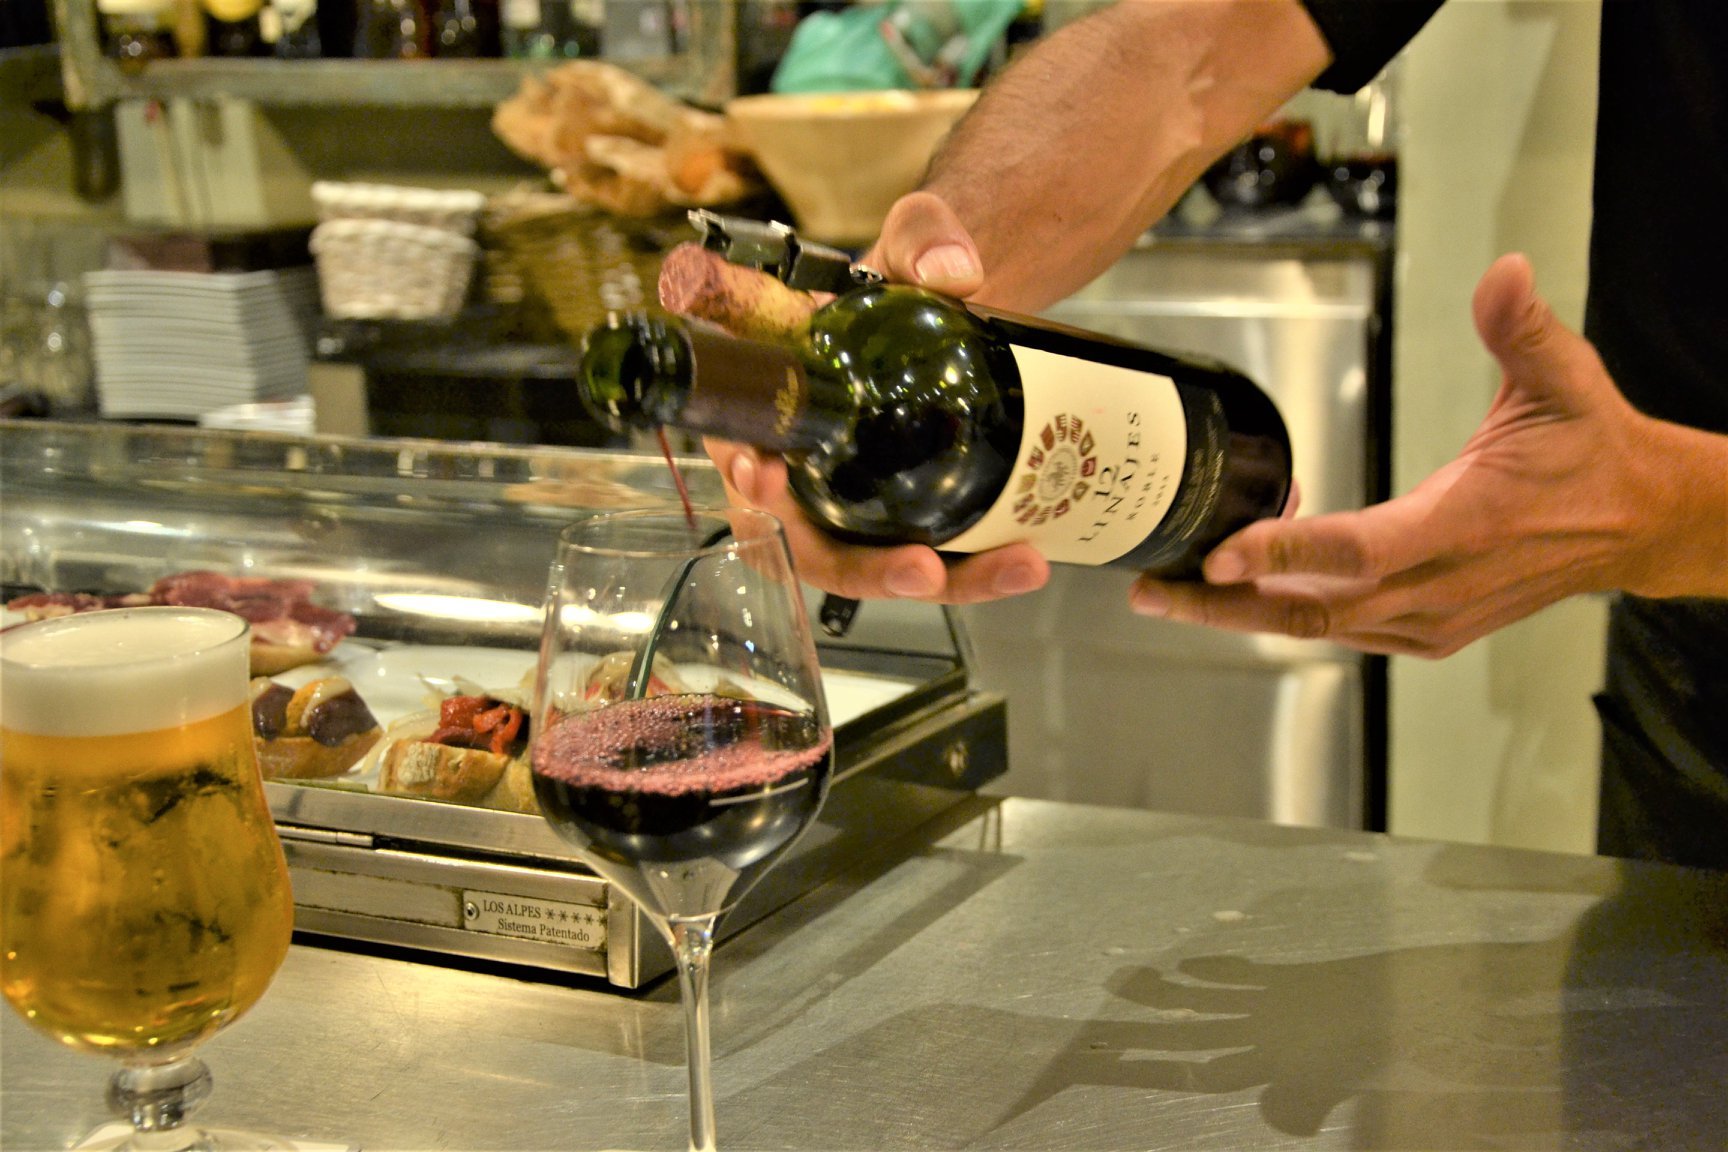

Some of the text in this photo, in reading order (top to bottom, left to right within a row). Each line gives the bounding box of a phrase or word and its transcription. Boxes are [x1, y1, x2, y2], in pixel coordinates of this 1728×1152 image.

[1076, 411, 1141, 541] LINAJES
[1094, 464, 1121, 501] 12
[483, 899, 541, 919] LOS ALPES
[498, 918, 590, 942] Sistema Patentado
